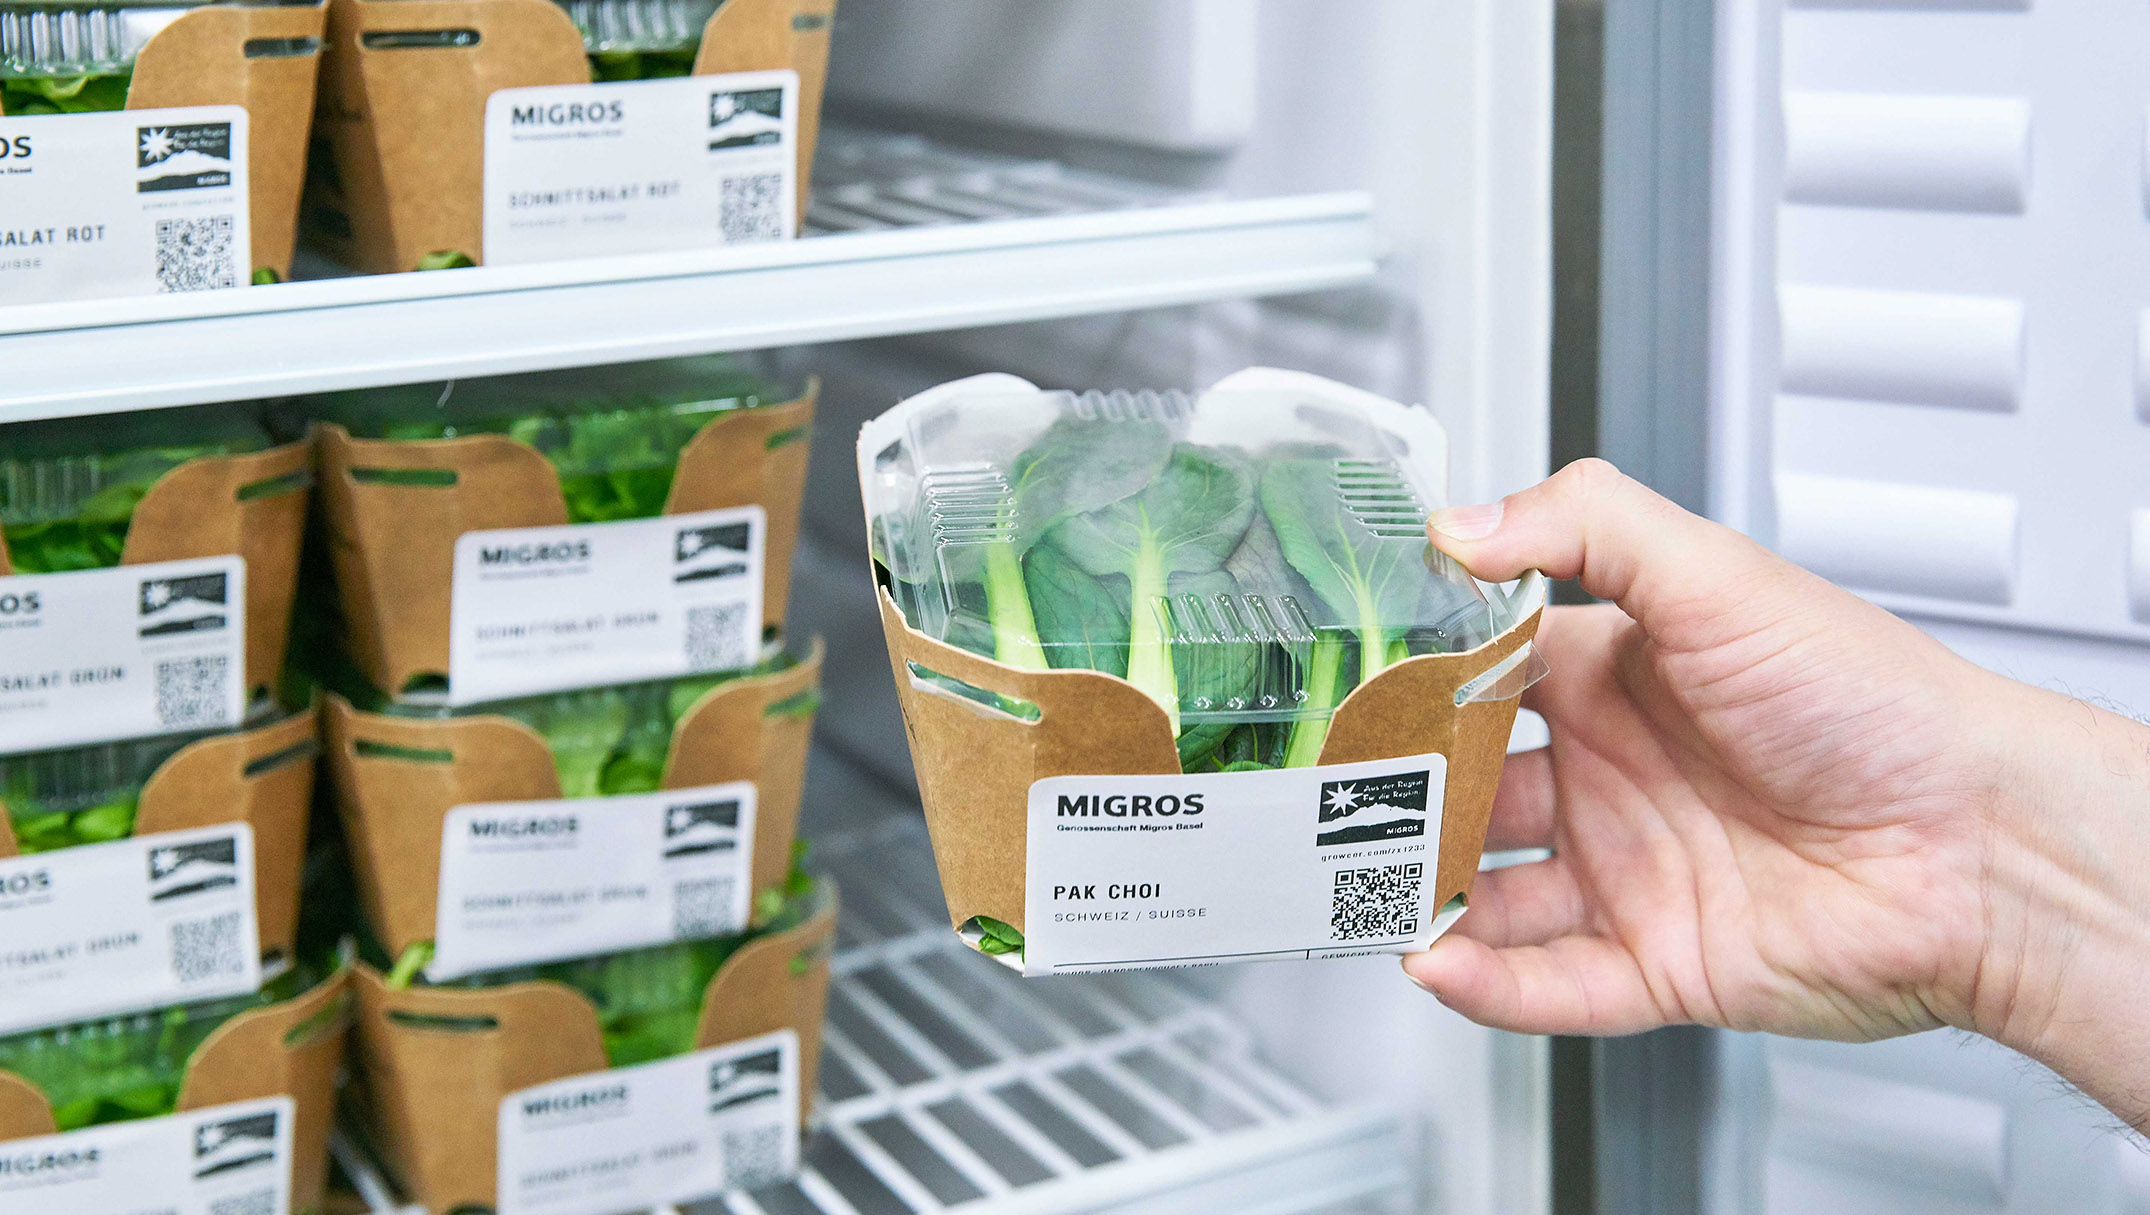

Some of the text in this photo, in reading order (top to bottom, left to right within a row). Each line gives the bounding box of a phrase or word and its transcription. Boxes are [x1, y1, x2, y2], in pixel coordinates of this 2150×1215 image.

[511, 99, 624, 126] MIGROS
[0, 224, 106, 247] ALAT ROT
[1363, 784, 1380, 793] Aus
[1057, 793, 1205, 817] MIGROS
[1056, 822, 1204, 833] Genossenschaft Migros Basel
[1386, 824, 1419, 835] MIGROS
[1053, 883, 1161, 901] PAK CHOI
[1054, 908, 1207, 923] SCHWEIZ / SUISSE
